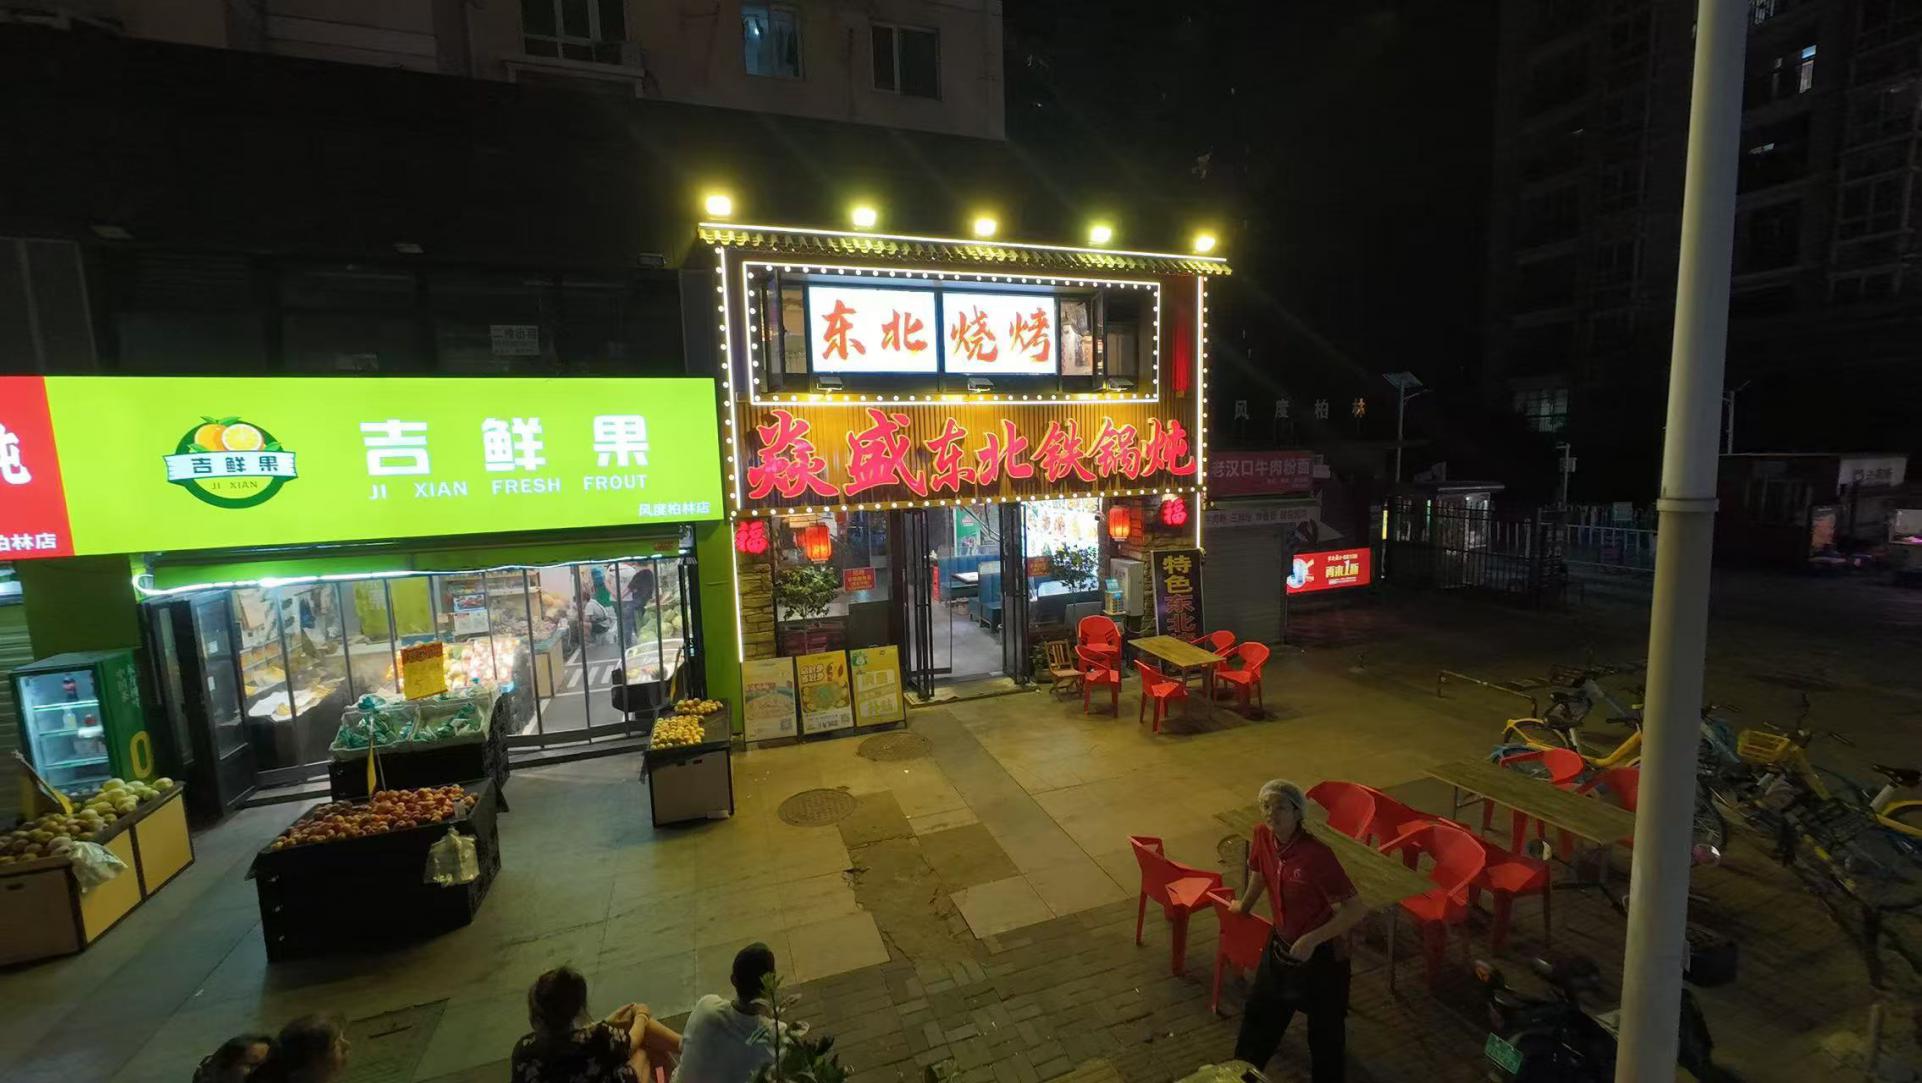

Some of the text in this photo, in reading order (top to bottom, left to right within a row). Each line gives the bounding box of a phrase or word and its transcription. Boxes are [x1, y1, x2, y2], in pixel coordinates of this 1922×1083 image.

[822, 299, 1051, 362] 东北烧烤
[1234, 397, 1368, 420] 风度柏林
[360, 414, 649, 476] 吉鲜果
[748, 408, 1196, 498] 焱盛东北铁锅炖
[191, 456, 278, 473] 吉鲜果
[212, 481, 258, 490] JI XIAN
[369, 474, 648, 500] JI XIAN FRESH FROUT
[639, 501, 710, 516] 风度柏林店
[1162, 554, 1198, 640] 特色东北
